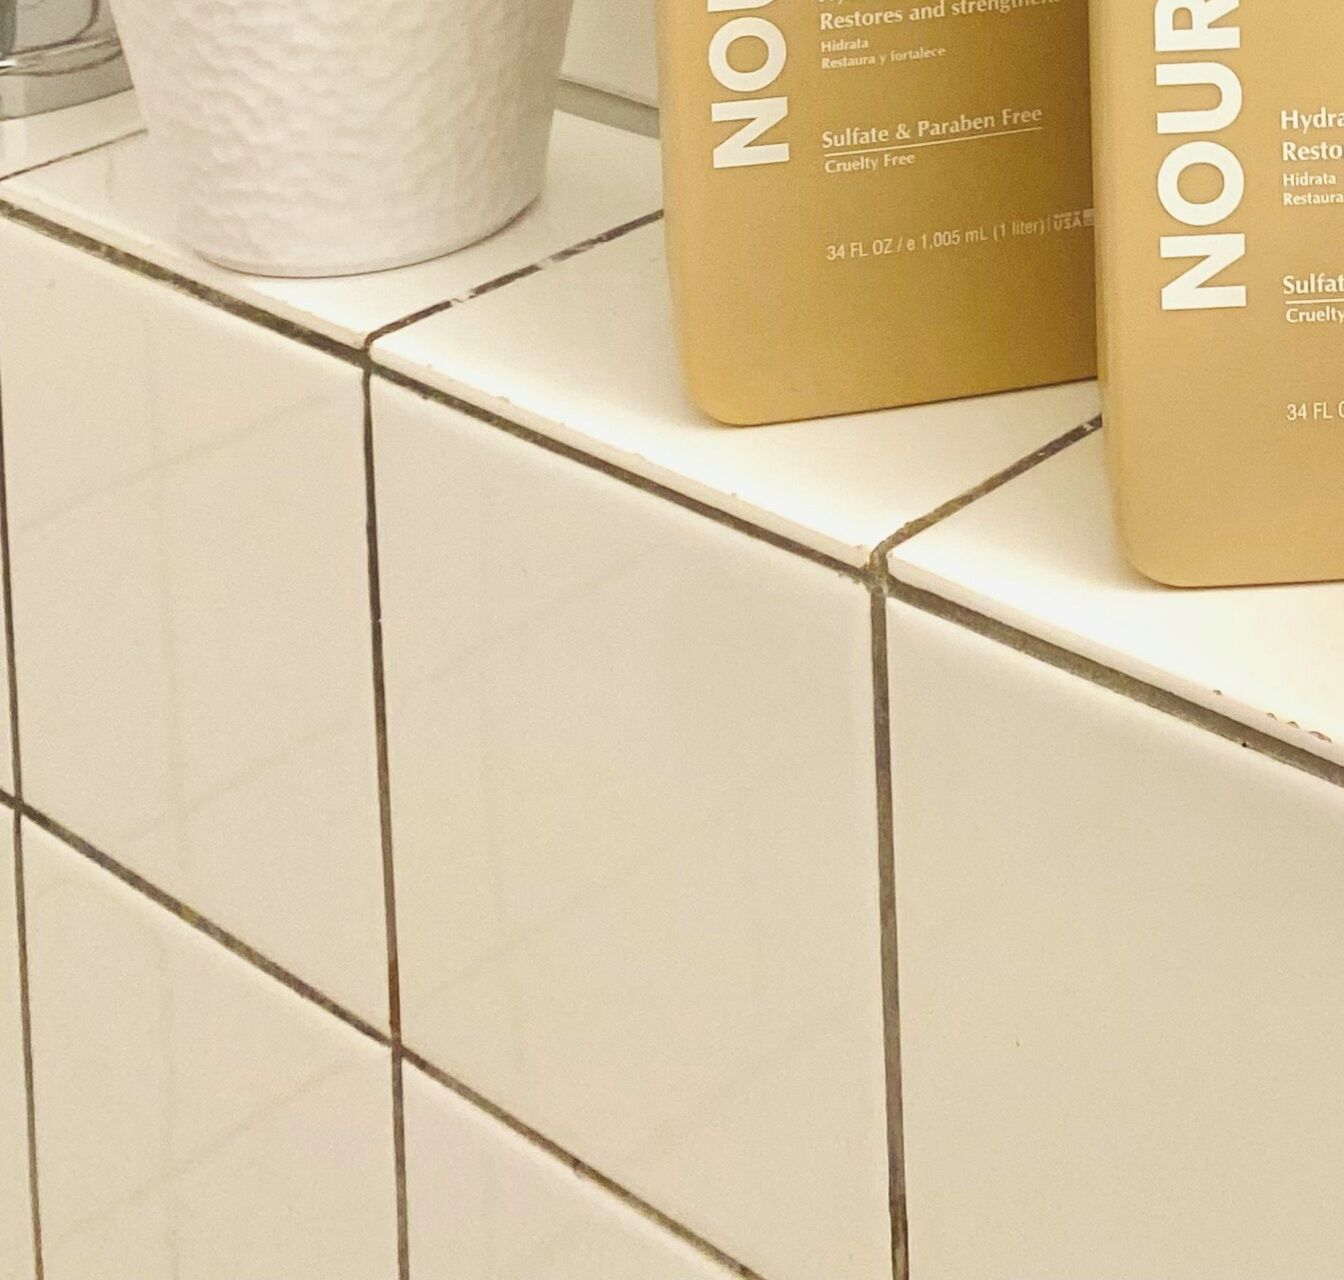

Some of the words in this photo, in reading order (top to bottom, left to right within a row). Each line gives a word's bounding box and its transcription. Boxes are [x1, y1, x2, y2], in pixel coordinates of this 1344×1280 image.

[820, 9, 903, 31] Restores
[909, 1, 946, 22] and
[820, 39, 869, 53] Hidrata
[821, 52, 876, 70] Restaura
[879, 53, 887, 65] y
[890, 44, 946, 62] fortalece
[822, 130, 889, 149] Sulfate
[895, 124, 912, 140] &
[917, 113, 996, 138] Paraben
[1001, 106, 1043, 127] Free
[824, 154, 879, 174] Cruelty
[884, 152, 916, 168] Free
[1282, 171, 1337, 187] Hidrata
[1282, 191, 1344, 207] Restaura
[826, 244, 846, 261] 34
[850, 241, 868, 258] FL
[872, 238, 892, 255] OZ
[919, 228, 961, 251] 1,005
[964, 225, 989, 242] mL
[993, 223, 1006, 241] (1
[1012, 218, 1045, 236] liter)
[1286, 403, 1308, 422] 34
[1313, 403, 1333, 420] FL
